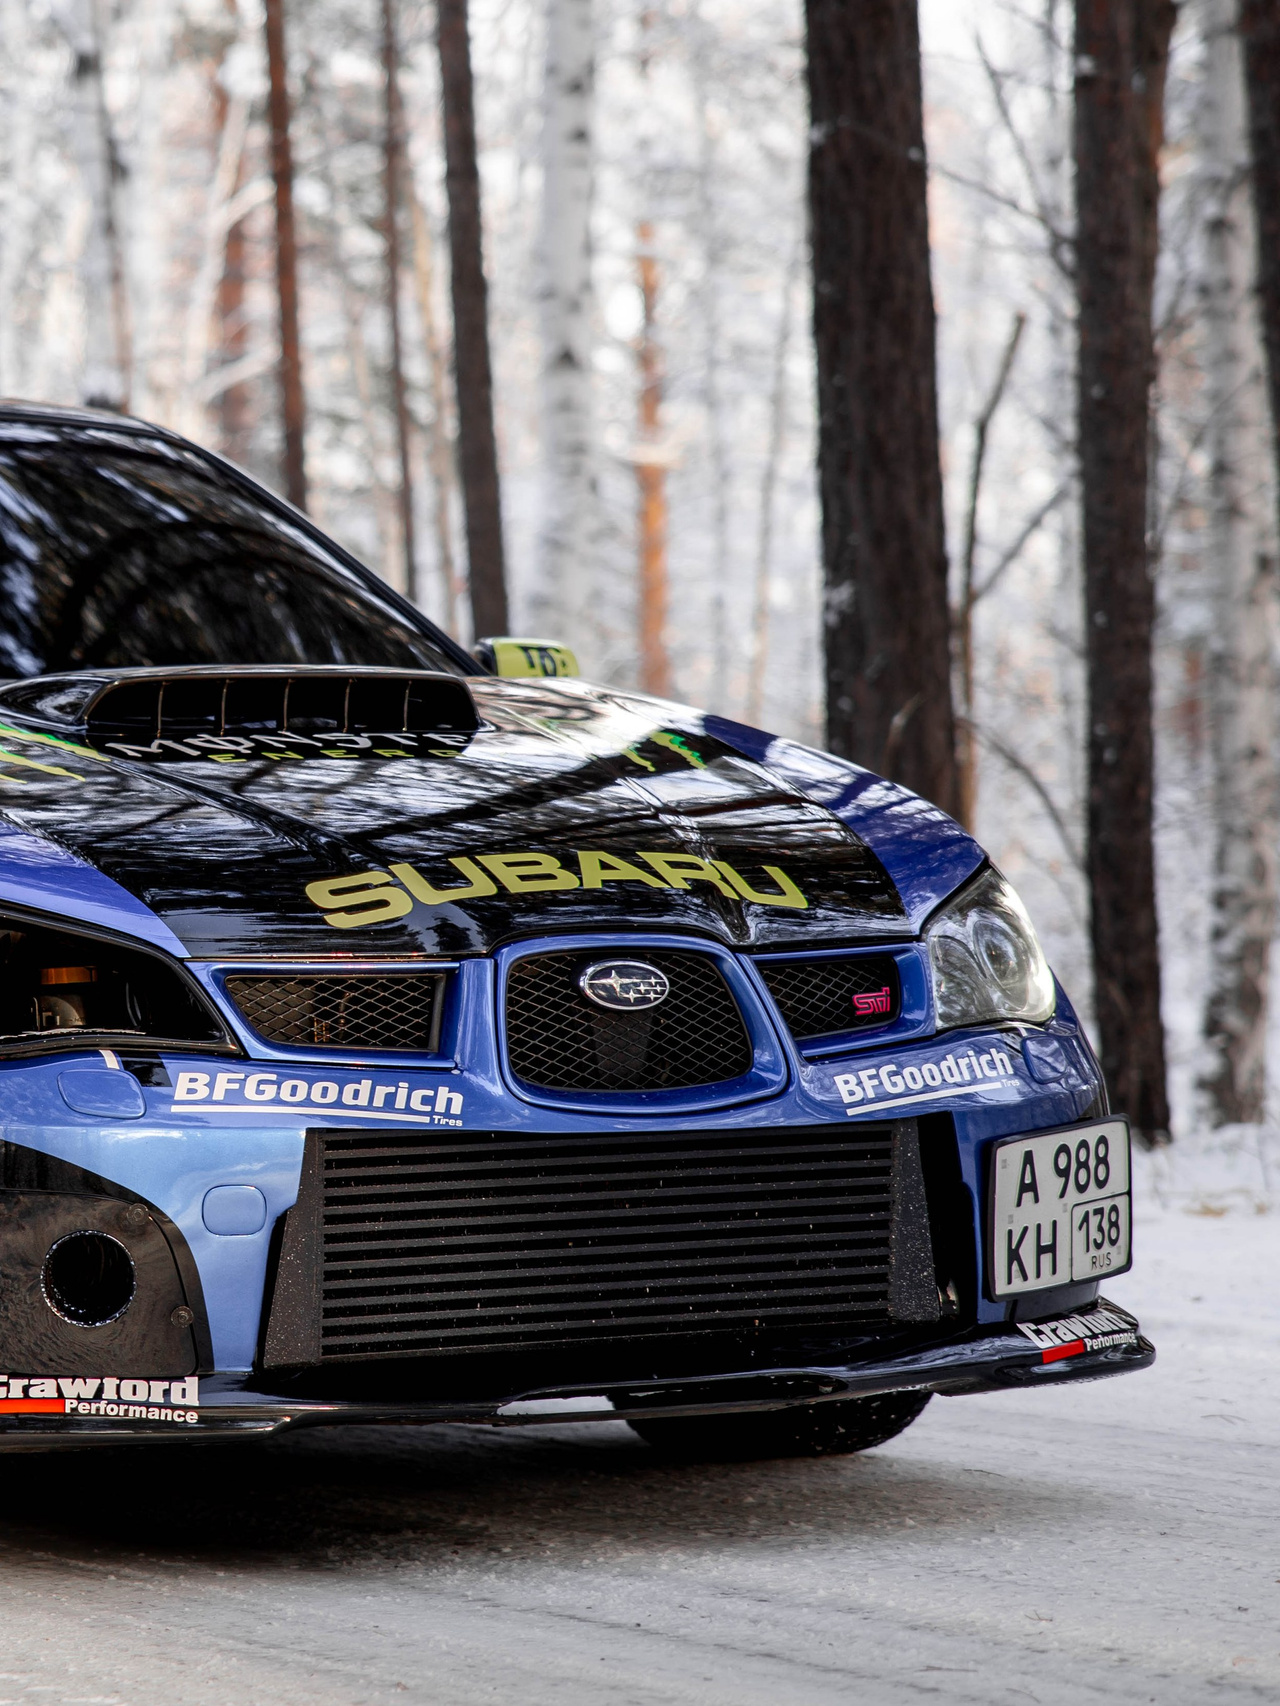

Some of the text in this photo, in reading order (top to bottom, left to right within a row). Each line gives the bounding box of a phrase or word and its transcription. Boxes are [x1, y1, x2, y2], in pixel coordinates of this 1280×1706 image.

[208, 748, 465, 764] ENERG
[306, 851, 809, 929] SUBARU
[173, 1072, 464, 1115] BFGoodrich
[834, 1048, 1014, 1104] BFGoodrich
[433, 1115, 463, 1127] Tires
[1053, 1135, 1110, 1199] 988
[1078, 1204, 1120, 1253] 138
[1091, 1252, 1112, 1271] RUS
[1016, 1308, 1131, 1349] Crawford
[65, 1399, 199, 1424] Performance
